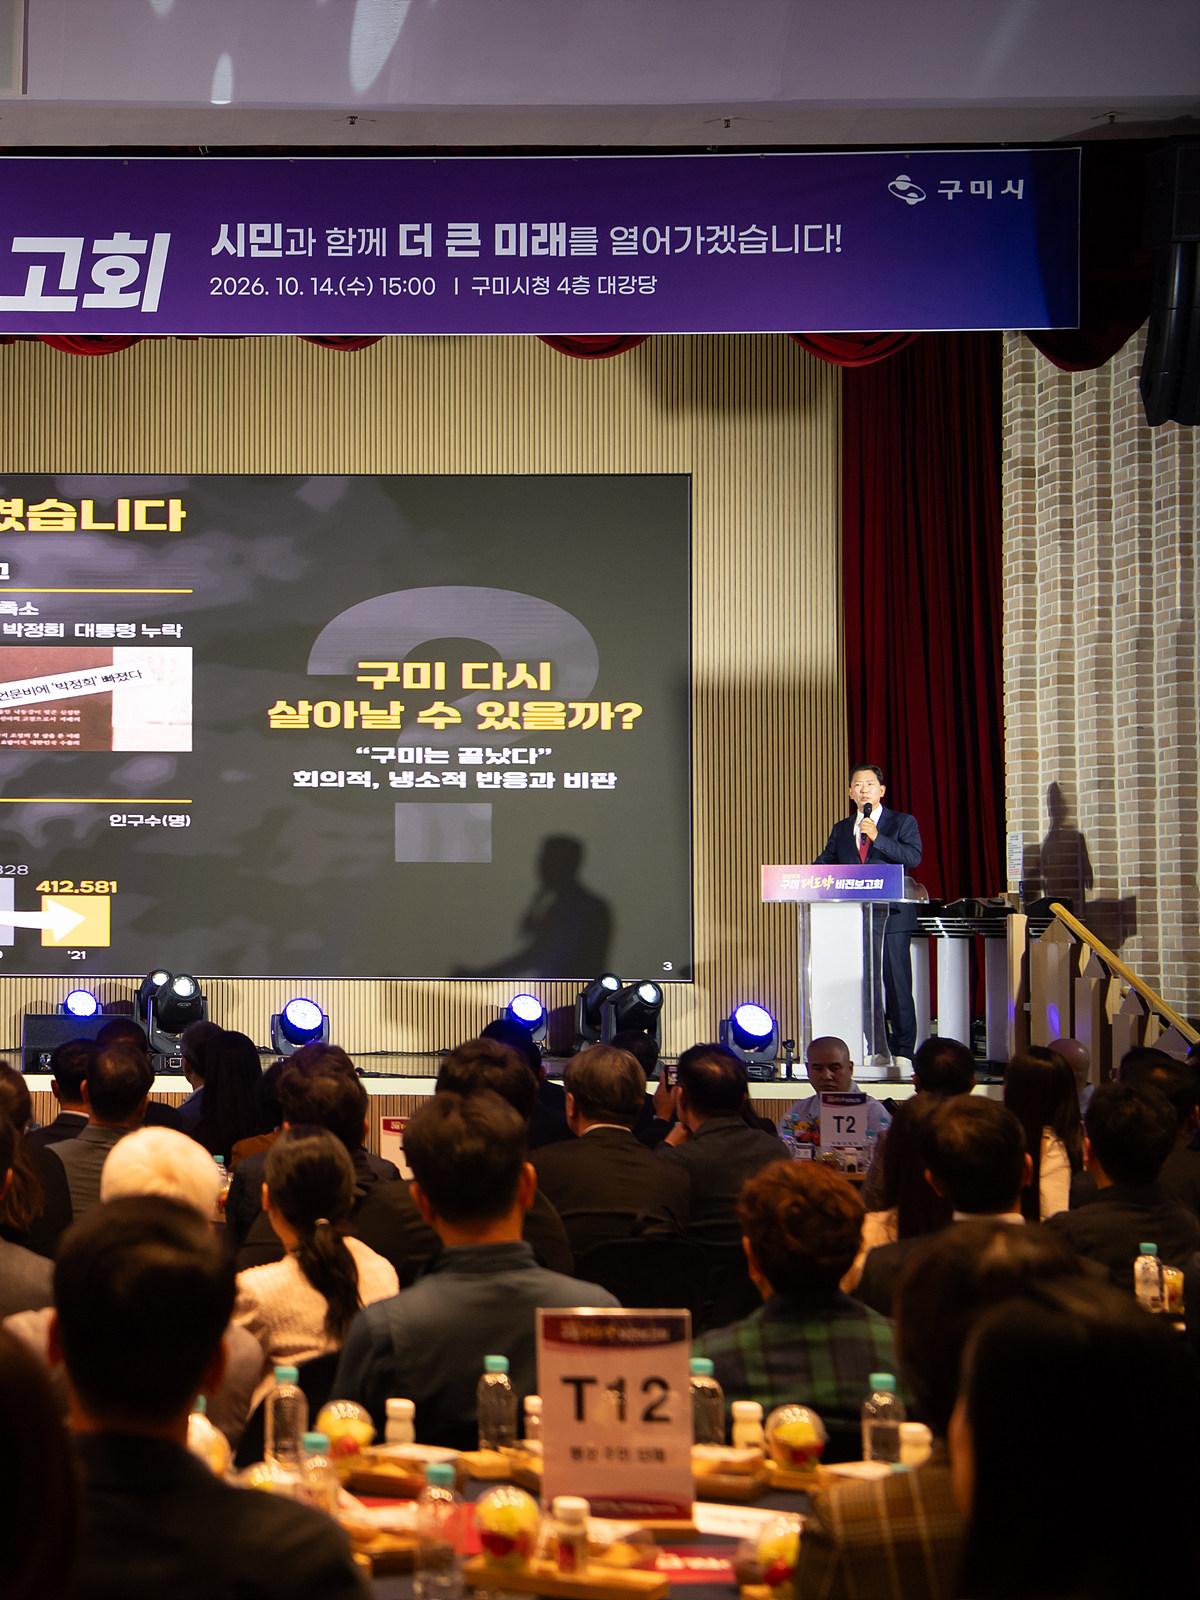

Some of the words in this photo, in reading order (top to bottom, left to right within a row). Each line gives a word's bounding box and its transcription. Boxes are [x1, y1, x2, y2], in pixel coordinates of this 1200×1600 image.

[937, 178, 1027, 201] 구미시
[211, 223, 317, 258] 시민과
[325, 225, 386, 258] 함께
[399, 222, 432, 258] 더
[446, 222, 481, 258] 큰
[495, 222, 599, 258] 미래를
[610, 225, 843, 257] 열어가겠습니다!
[210, 276, 270, 297] 2026.
[278, 276, 306, 297] 10.
[310, 275, 374, 298] 14.(수)
[380, 276, 437, 297] 15:00
[471, 275, 552, 297] 구미시청
[557, 275, 592, 297] 4층
[598, 275, 657, 297] 대강당
[3, 622, 64, 638] 박정희
[75, 623, 136, 638] 대통령
[142, 623, 183, 638] 누락
[102, 669, 142, 684] 빠졌다
[357, 661, 446, 691] 구미
[461, 661, 551, 691] 다시
[267, 700, 404, 730] 살아날
[417, 701, 462, 730] 수
[476, 701, 643, 731] 있을까?
[292, 771, 379, 789] 회의적,
[389, 771, 467, 789] 냉소적
[476, 772, 555, 789] 반응과
[563, 772, 617, 789] 비판
[110, 814, 191, 828] 인구수(명)
[663, 961, 673, 971] 3
[832, 1115, 856, 1134] T2
[561, 1375, 670, 1423] T12
